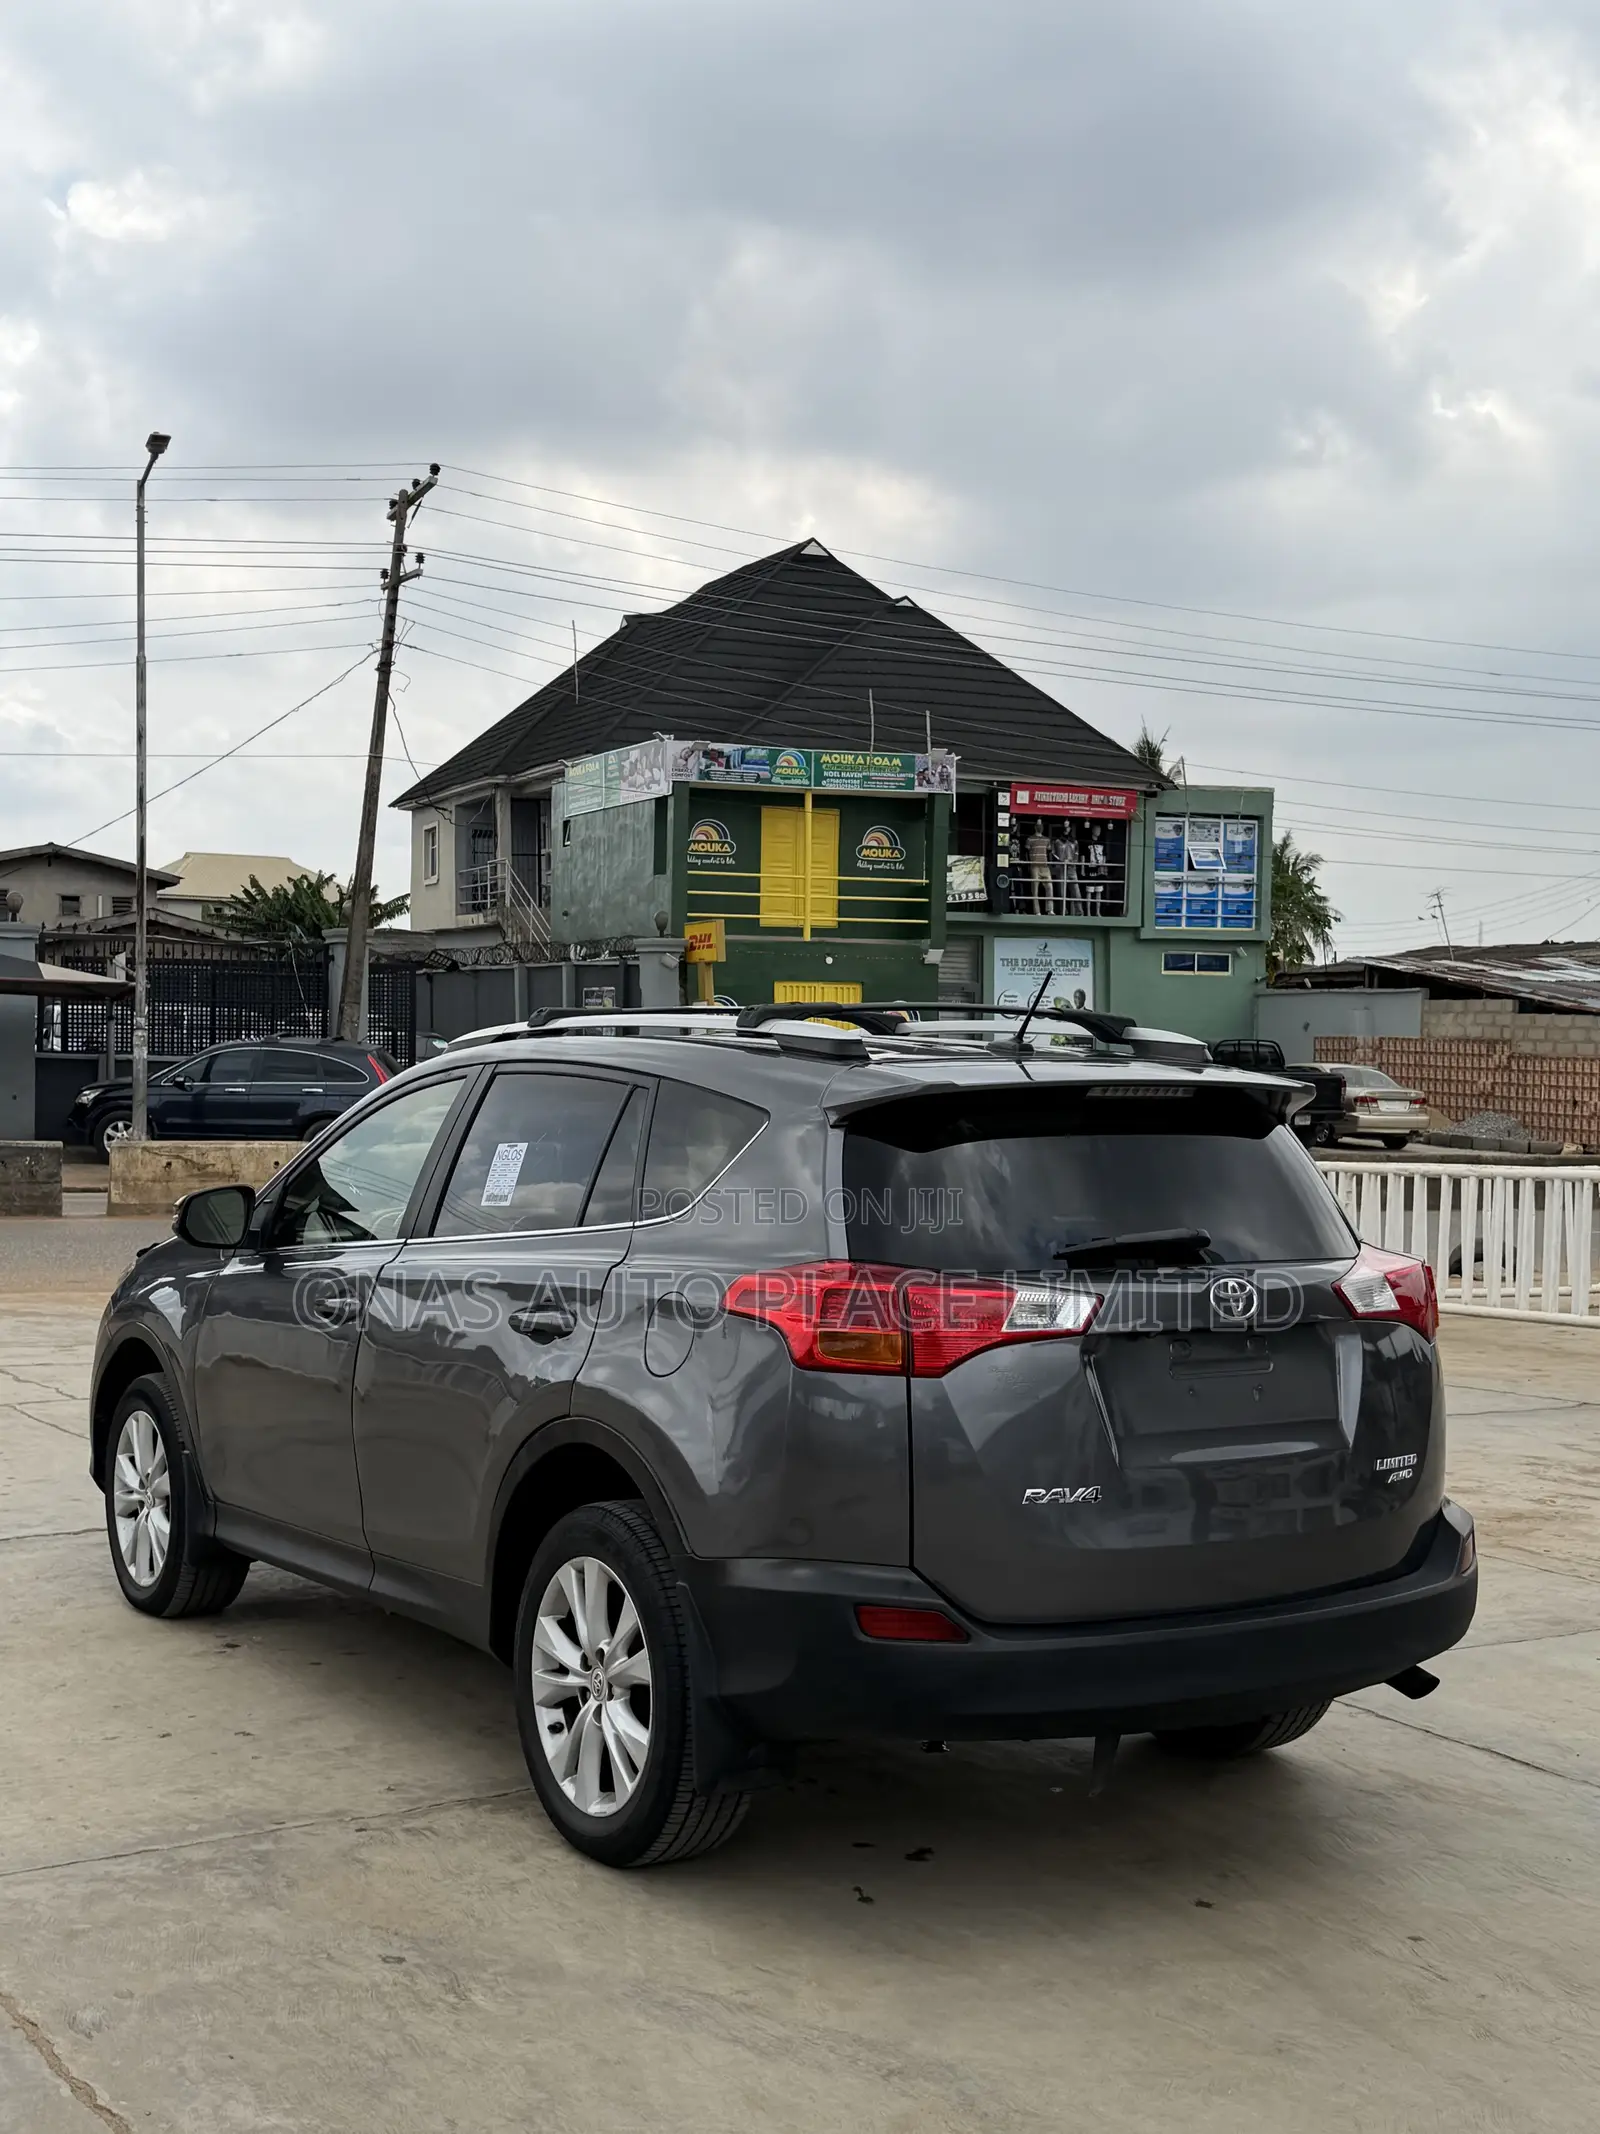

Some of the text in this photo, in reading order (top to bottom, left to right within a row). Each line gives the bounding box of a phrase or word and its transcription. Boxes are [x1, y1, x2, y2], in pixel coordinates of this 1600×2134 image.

[820, 753, 902, 766] MOUKA FOAM
[774, 767, 807, 775] MOUKA
[688, 842, 731, 852] MOUKA
[861, 848, 901, 858] MOUKA
[689, 933, 714, 952] DHL
[1000, 958, 1090, 968] THE DREAM CENTRE
[1374, 1453, 1417, 1471] LIMITED
[1387, 1468, 1413, 1484] AWD
[1022, 1485, 1102, 1505] RAV4
